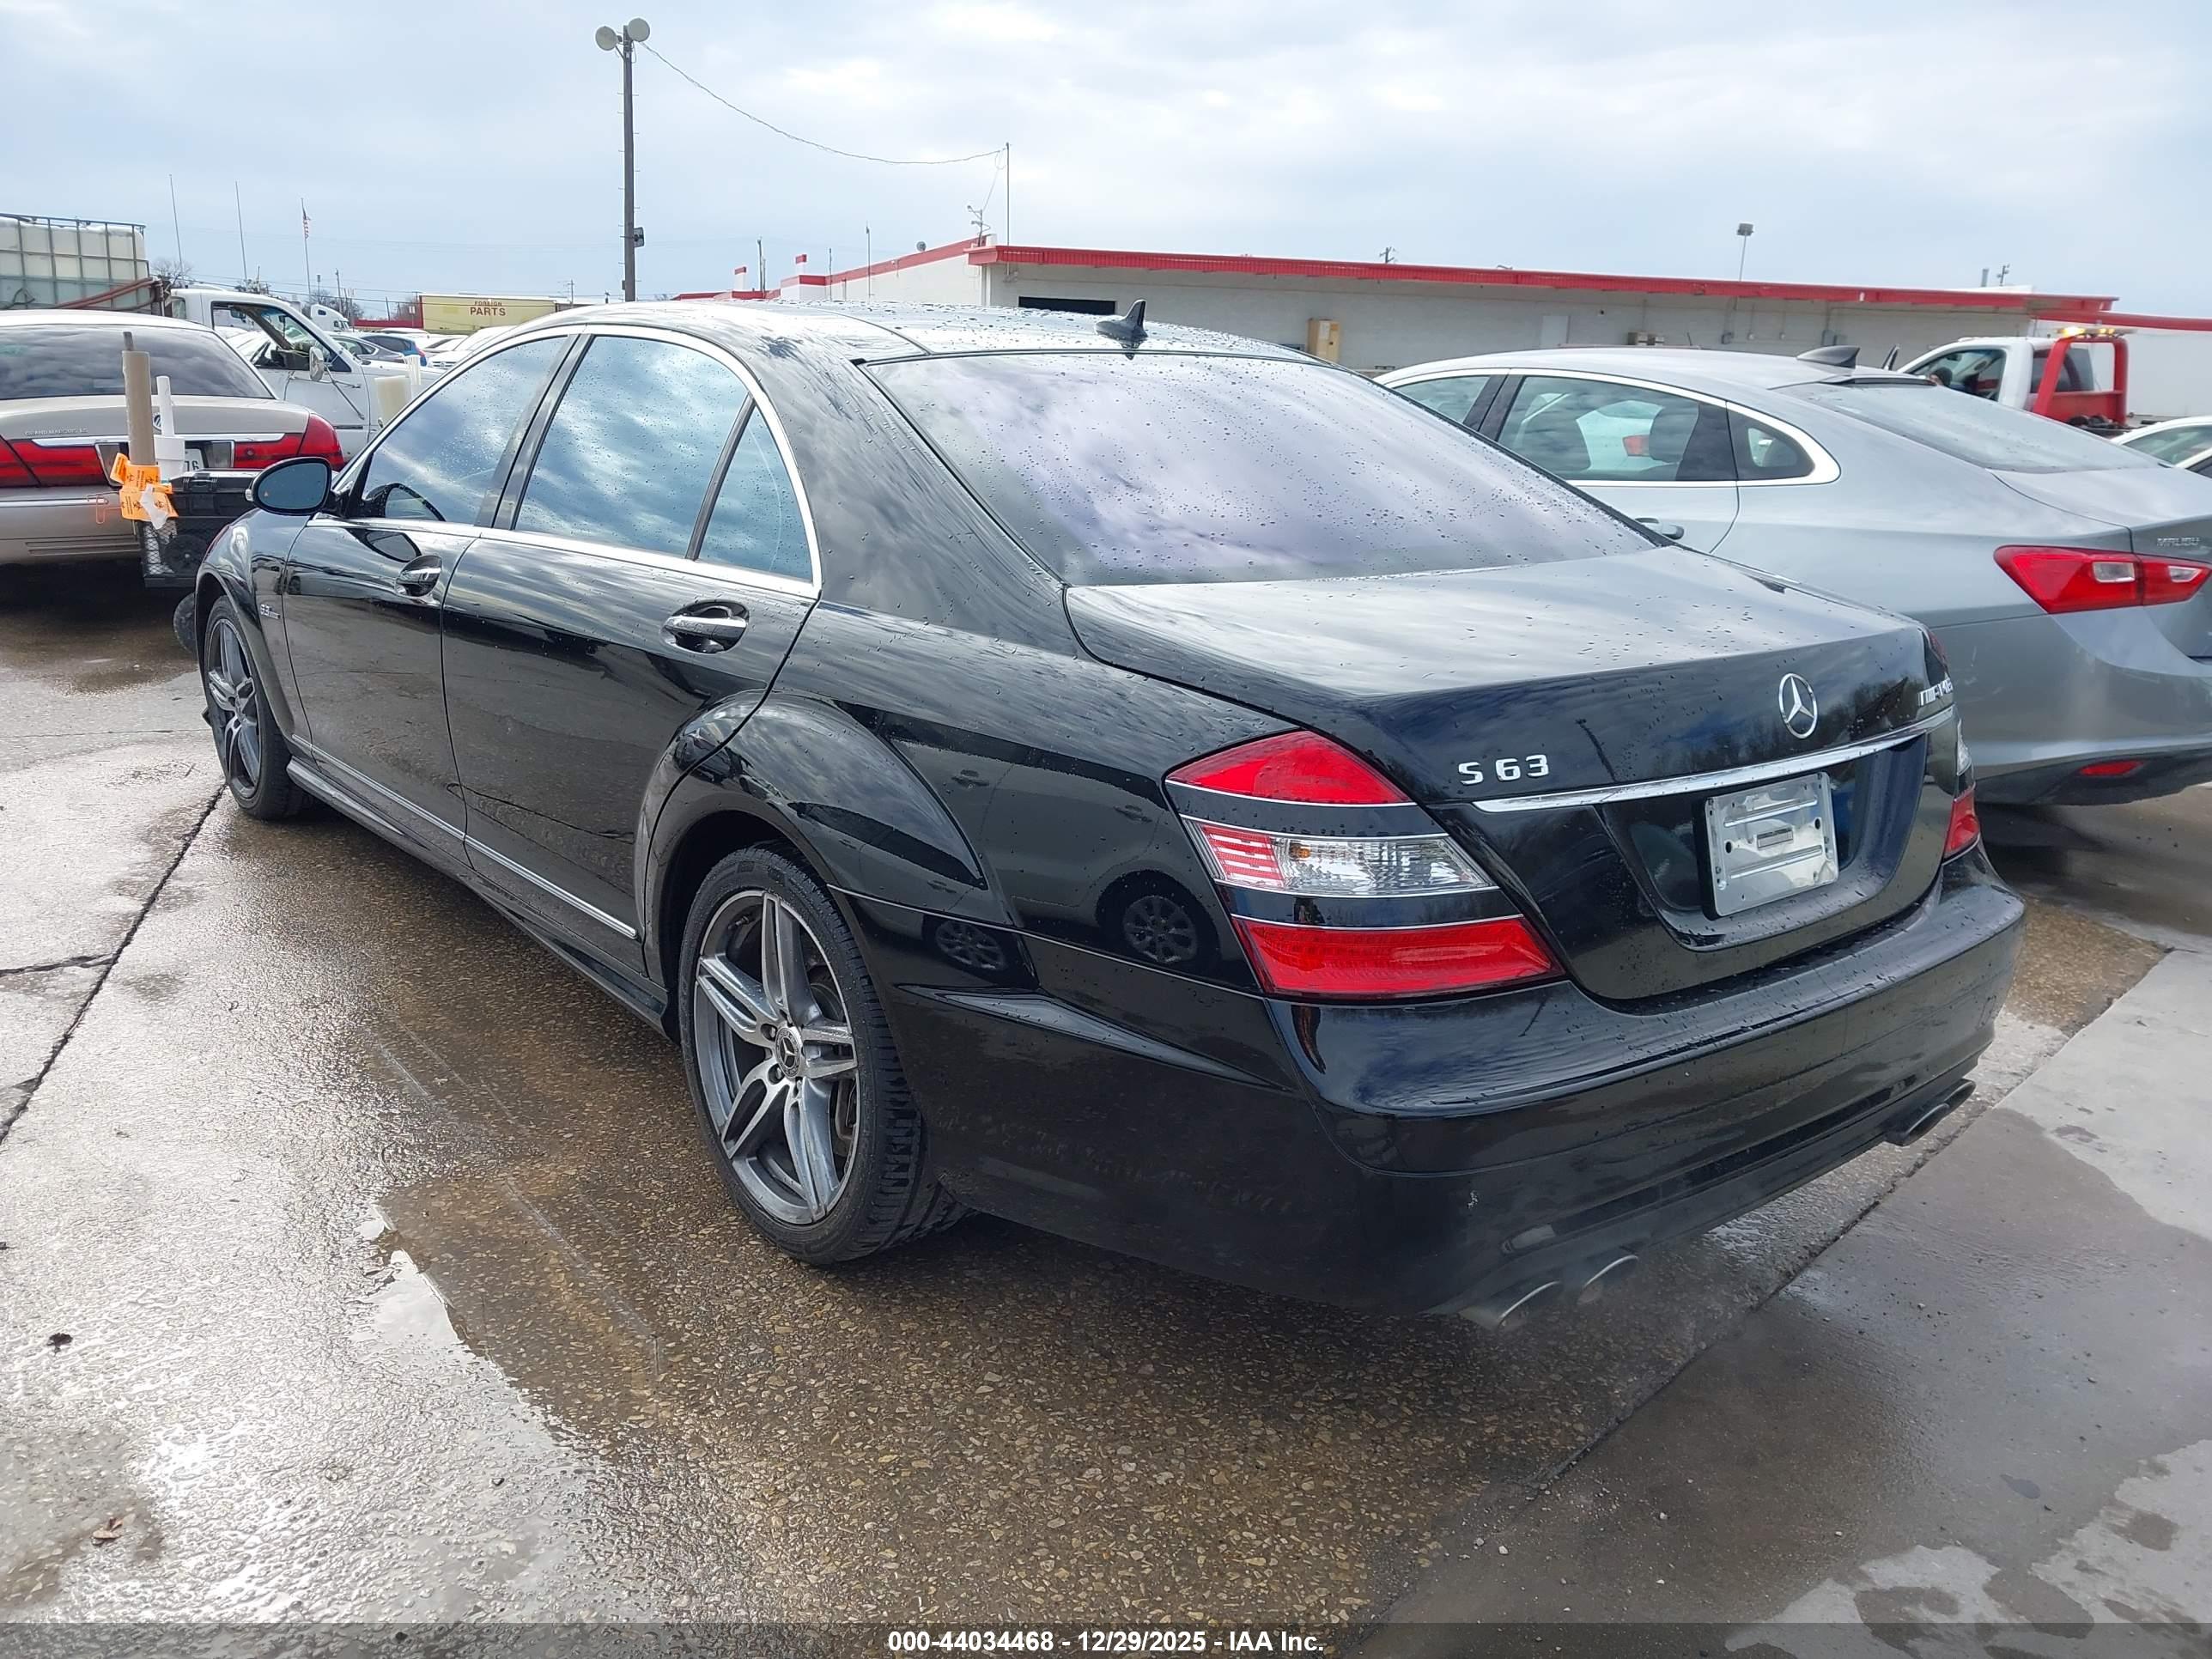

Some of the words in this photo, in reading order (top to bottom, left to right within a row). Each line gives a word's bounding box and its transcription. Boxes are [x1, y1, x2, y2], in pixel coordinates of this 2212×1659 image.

[470, 307, 507, 316] PARTS
[2157, 537, 2201, 547] MALIBU
[1458, 762, 1484, 786] S
[1495, 754, 1549, 782] 63
